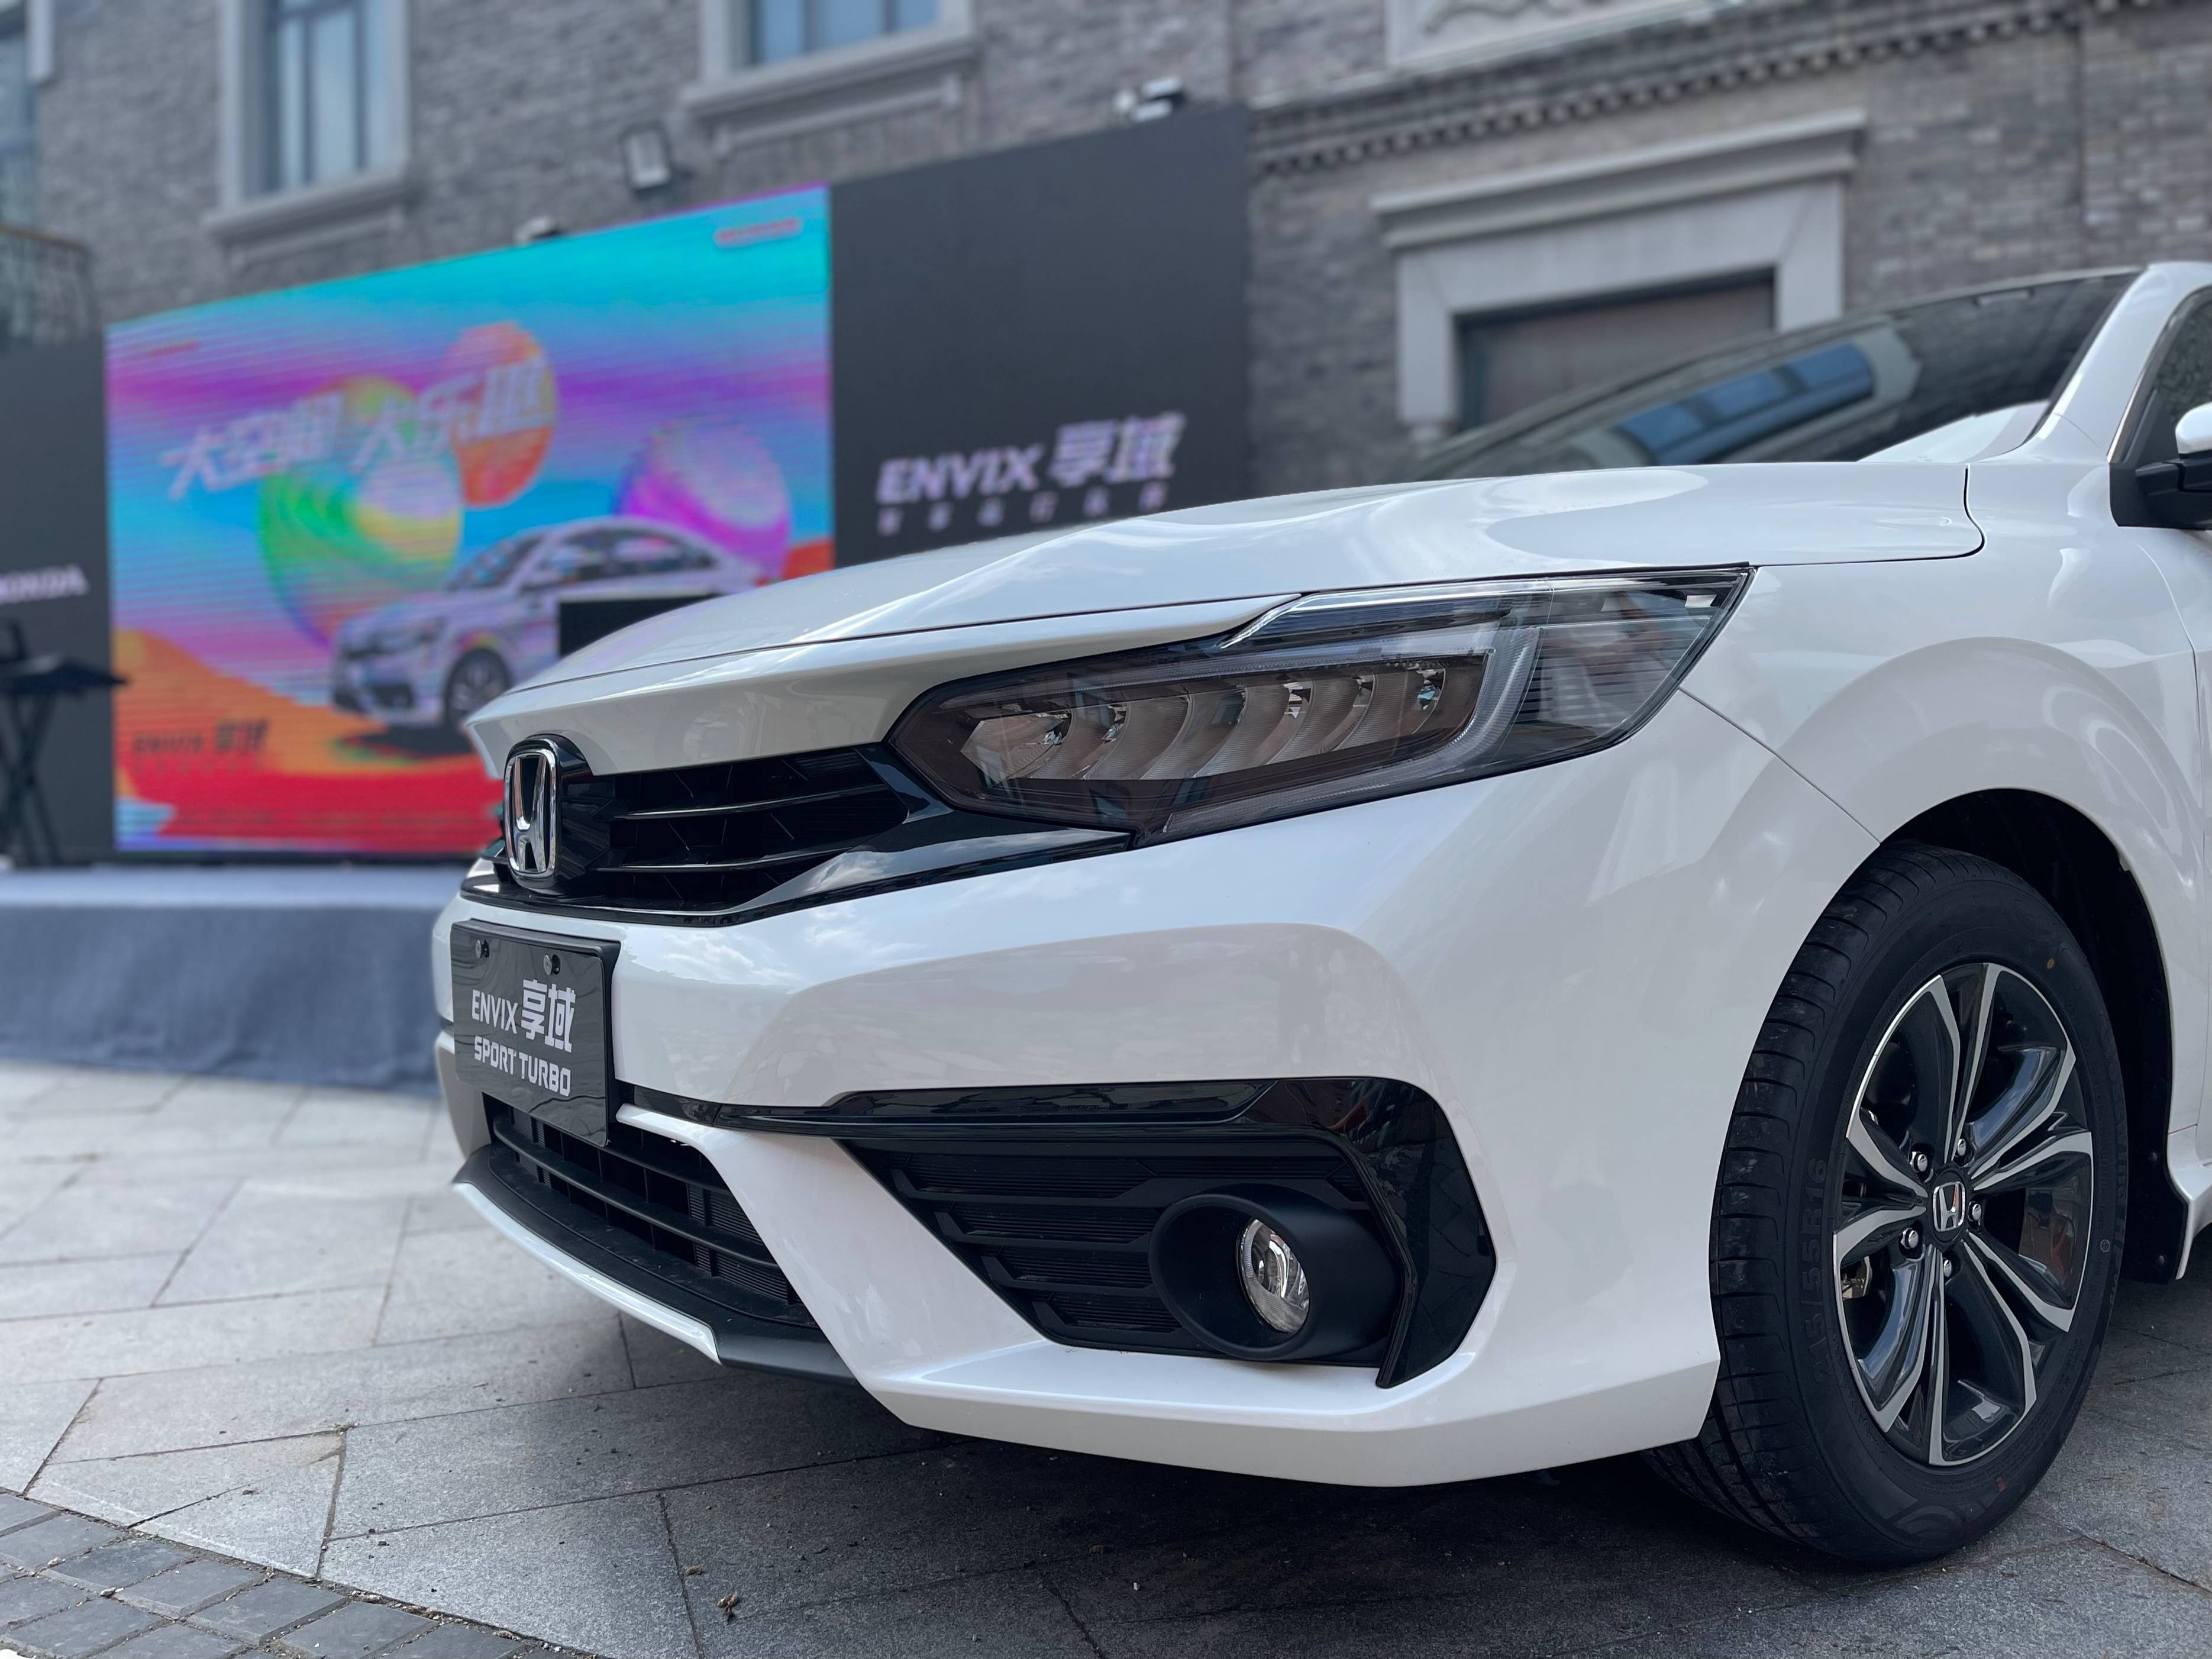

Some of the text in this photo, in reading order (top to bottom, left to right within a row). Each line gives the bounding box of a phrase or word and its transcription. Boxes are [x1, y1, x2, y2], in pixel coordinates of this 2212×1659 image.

[876, 442, 1046, 505] ENVIX
[471, 979, 576, 1053] ENVIX 享域
[474, 1035, 572, 1097] SPORT TURBO
